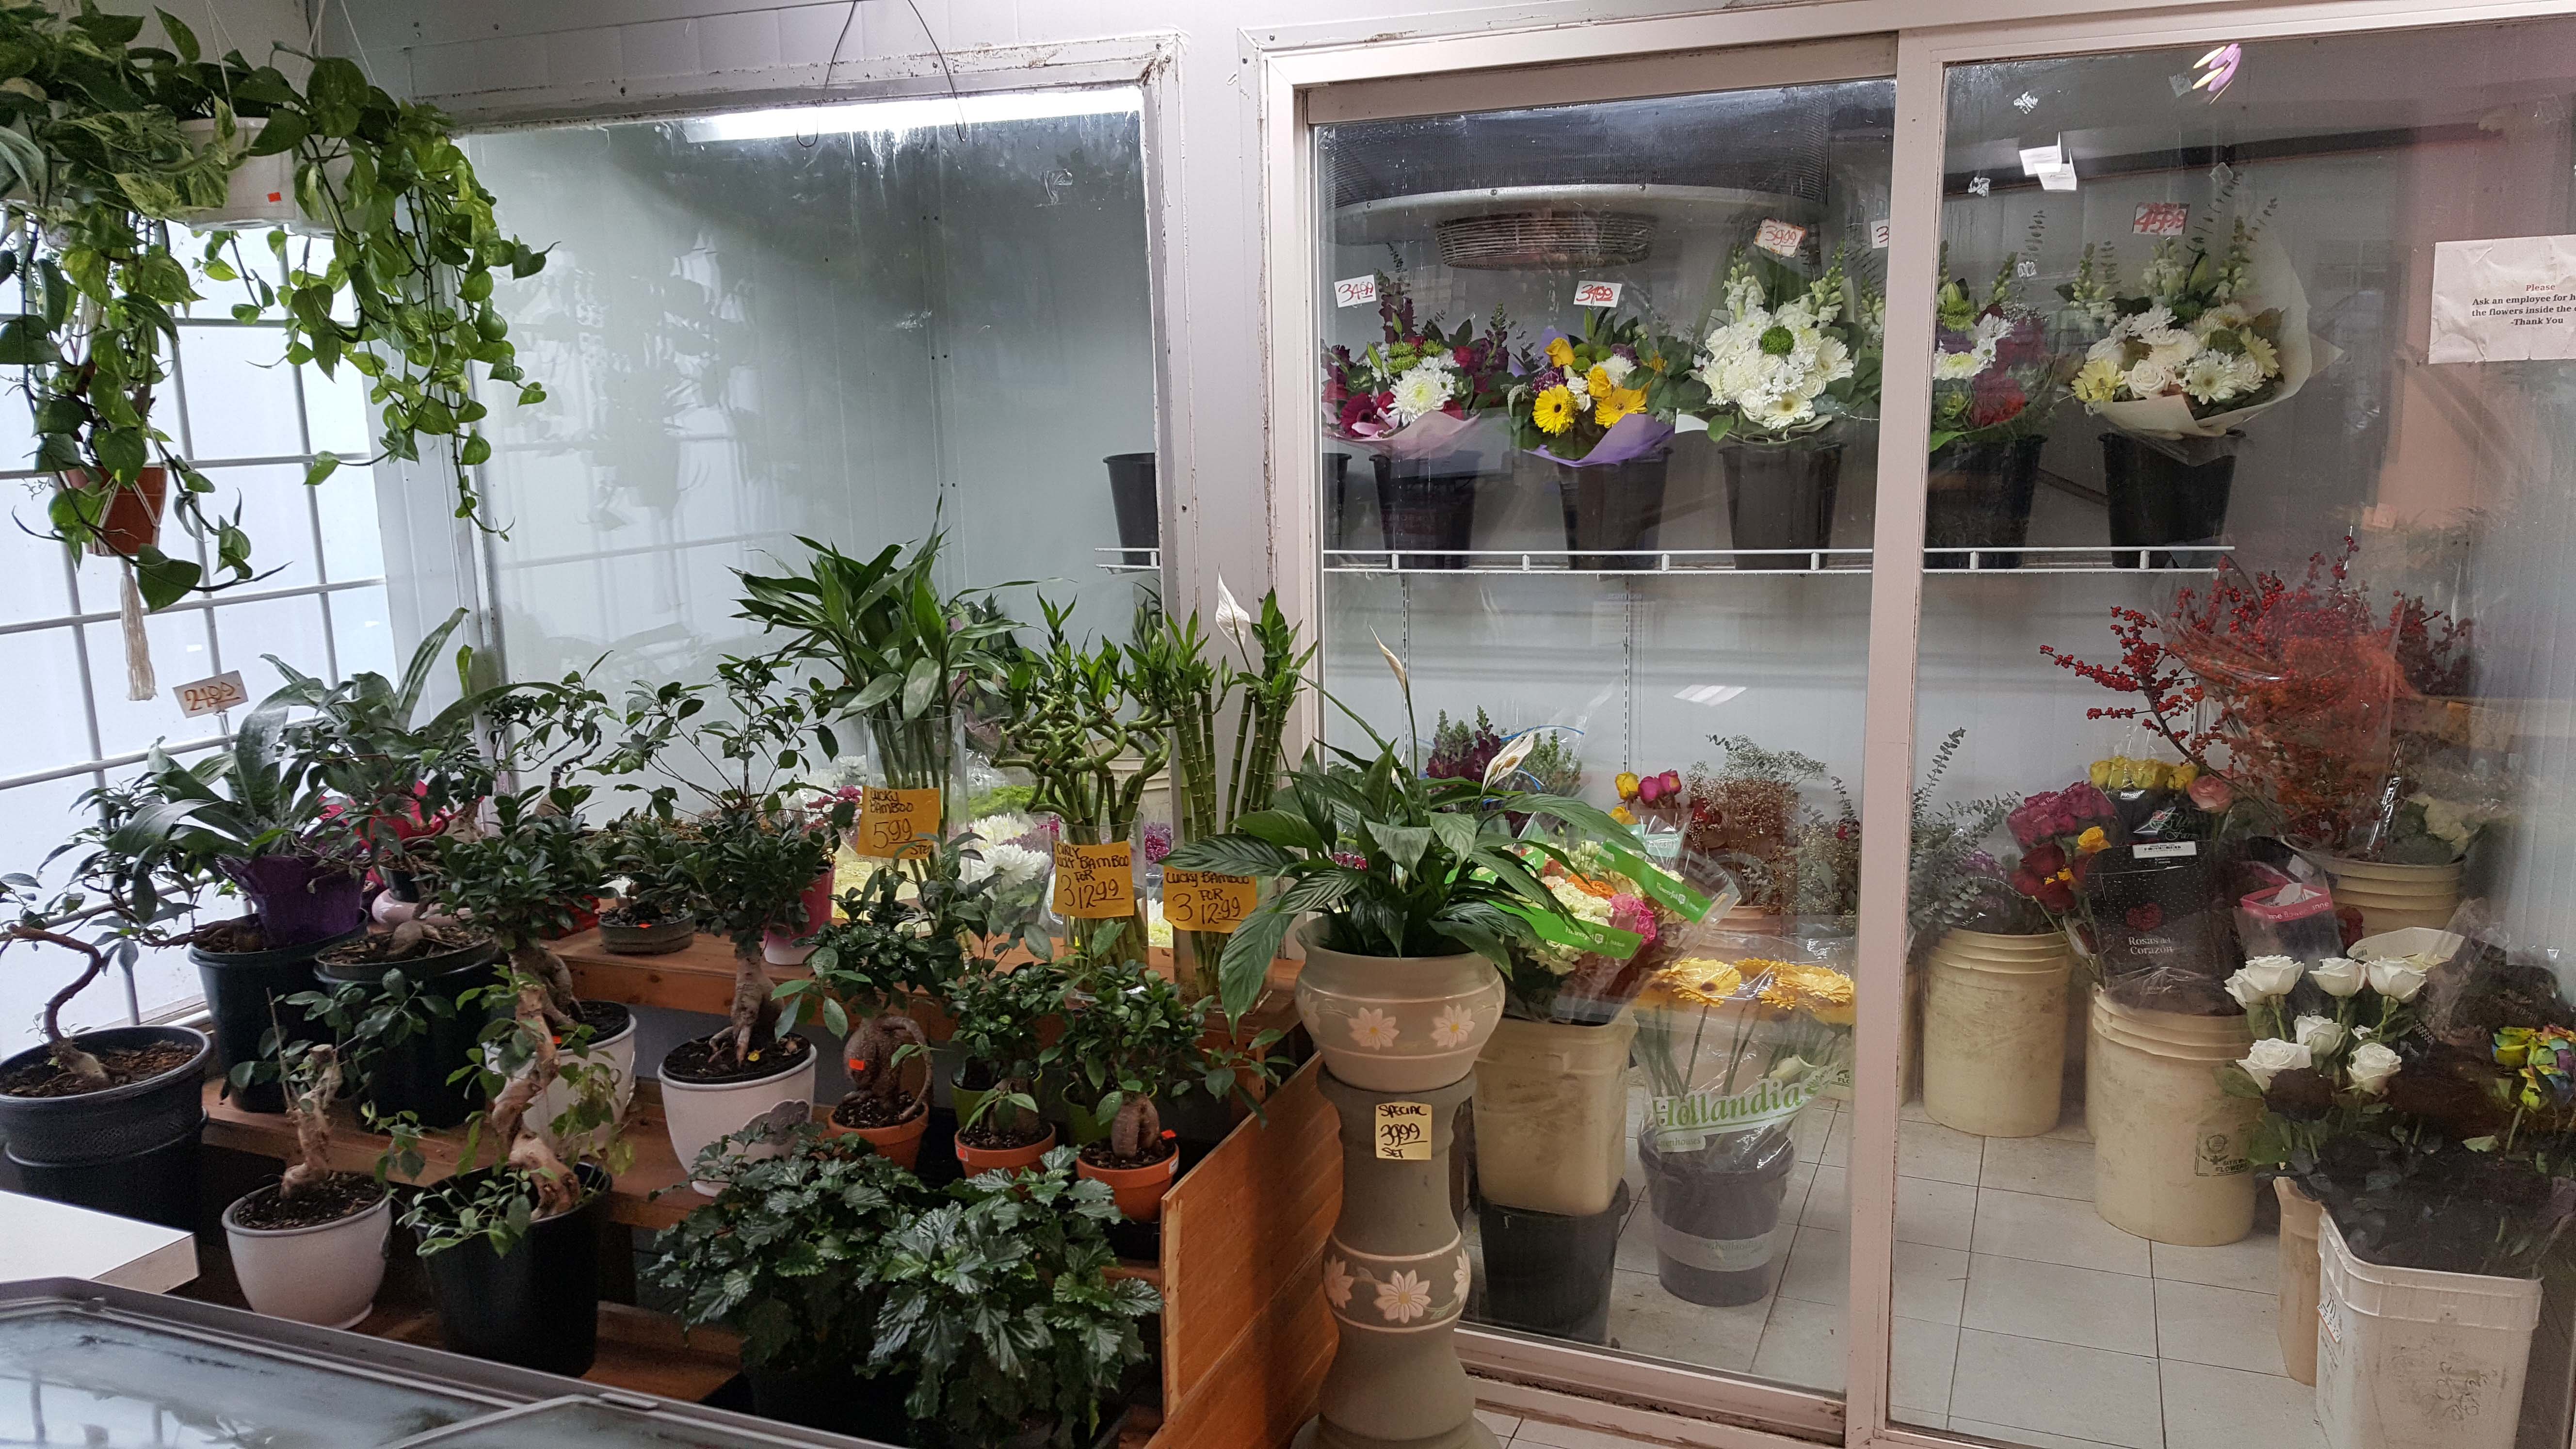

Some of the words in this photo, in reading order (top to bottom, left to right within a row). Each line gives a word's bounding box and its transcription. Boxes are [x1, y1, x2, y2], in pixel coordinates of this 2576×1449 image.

[2506, 295, 2551, 305] employee
[2526, 306, 2554, 314] inside
[2511, 317, 2544, 325] -Thank
[1079, 855, 1129, 869] BAMBOO
[1074, 869, 1095, 883] FOR
[1201, 870, 1250, 885] BAMBOO
[1061, 874, 1076, 907] 3
[1198, 888, 1224, 901] FOR
[1172, 893, 1193, 921] 3
[2128, 936, 2158, 945] Rosas
[1653, 1080, 1803, 1127] Hollandia
[1378, 1104, 1428, 1118] SPECIAL
[1381, 1147, 1404, 1159] SET
